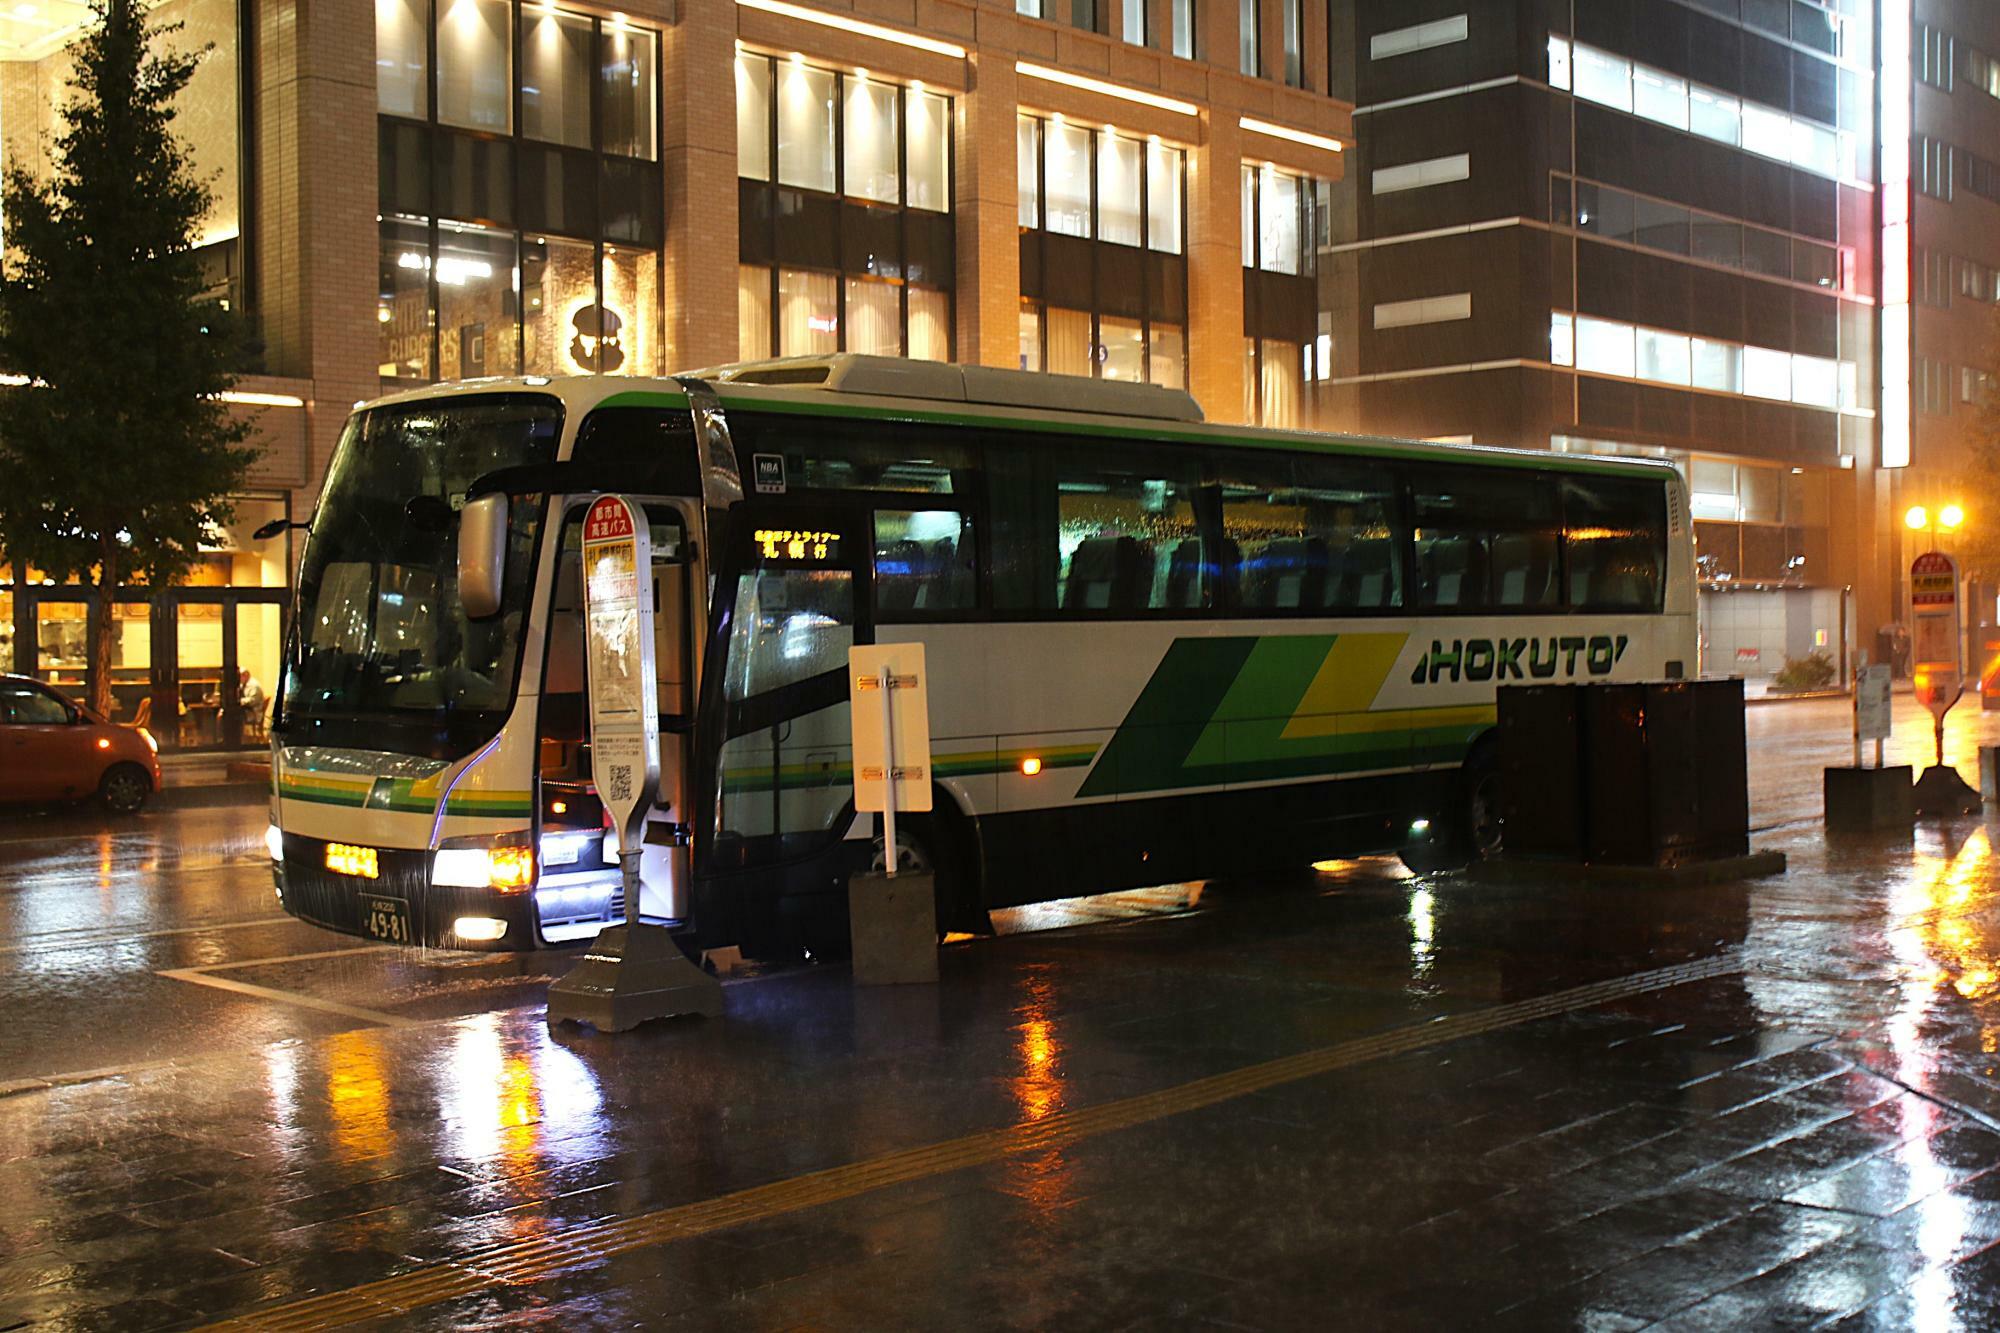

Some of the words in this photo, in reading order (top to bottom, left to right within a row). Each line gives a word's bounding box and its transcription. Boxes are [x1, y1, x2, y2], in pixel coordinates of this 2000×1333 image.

[389, 328, 458, 366] BURGRS
[760, 462, 779, 474] NBA
[595, 503, 623, 521] 都市間
[591, 519, 628, 538] 高速バス
[1427, 634, 1616, 684] HOKUTO
